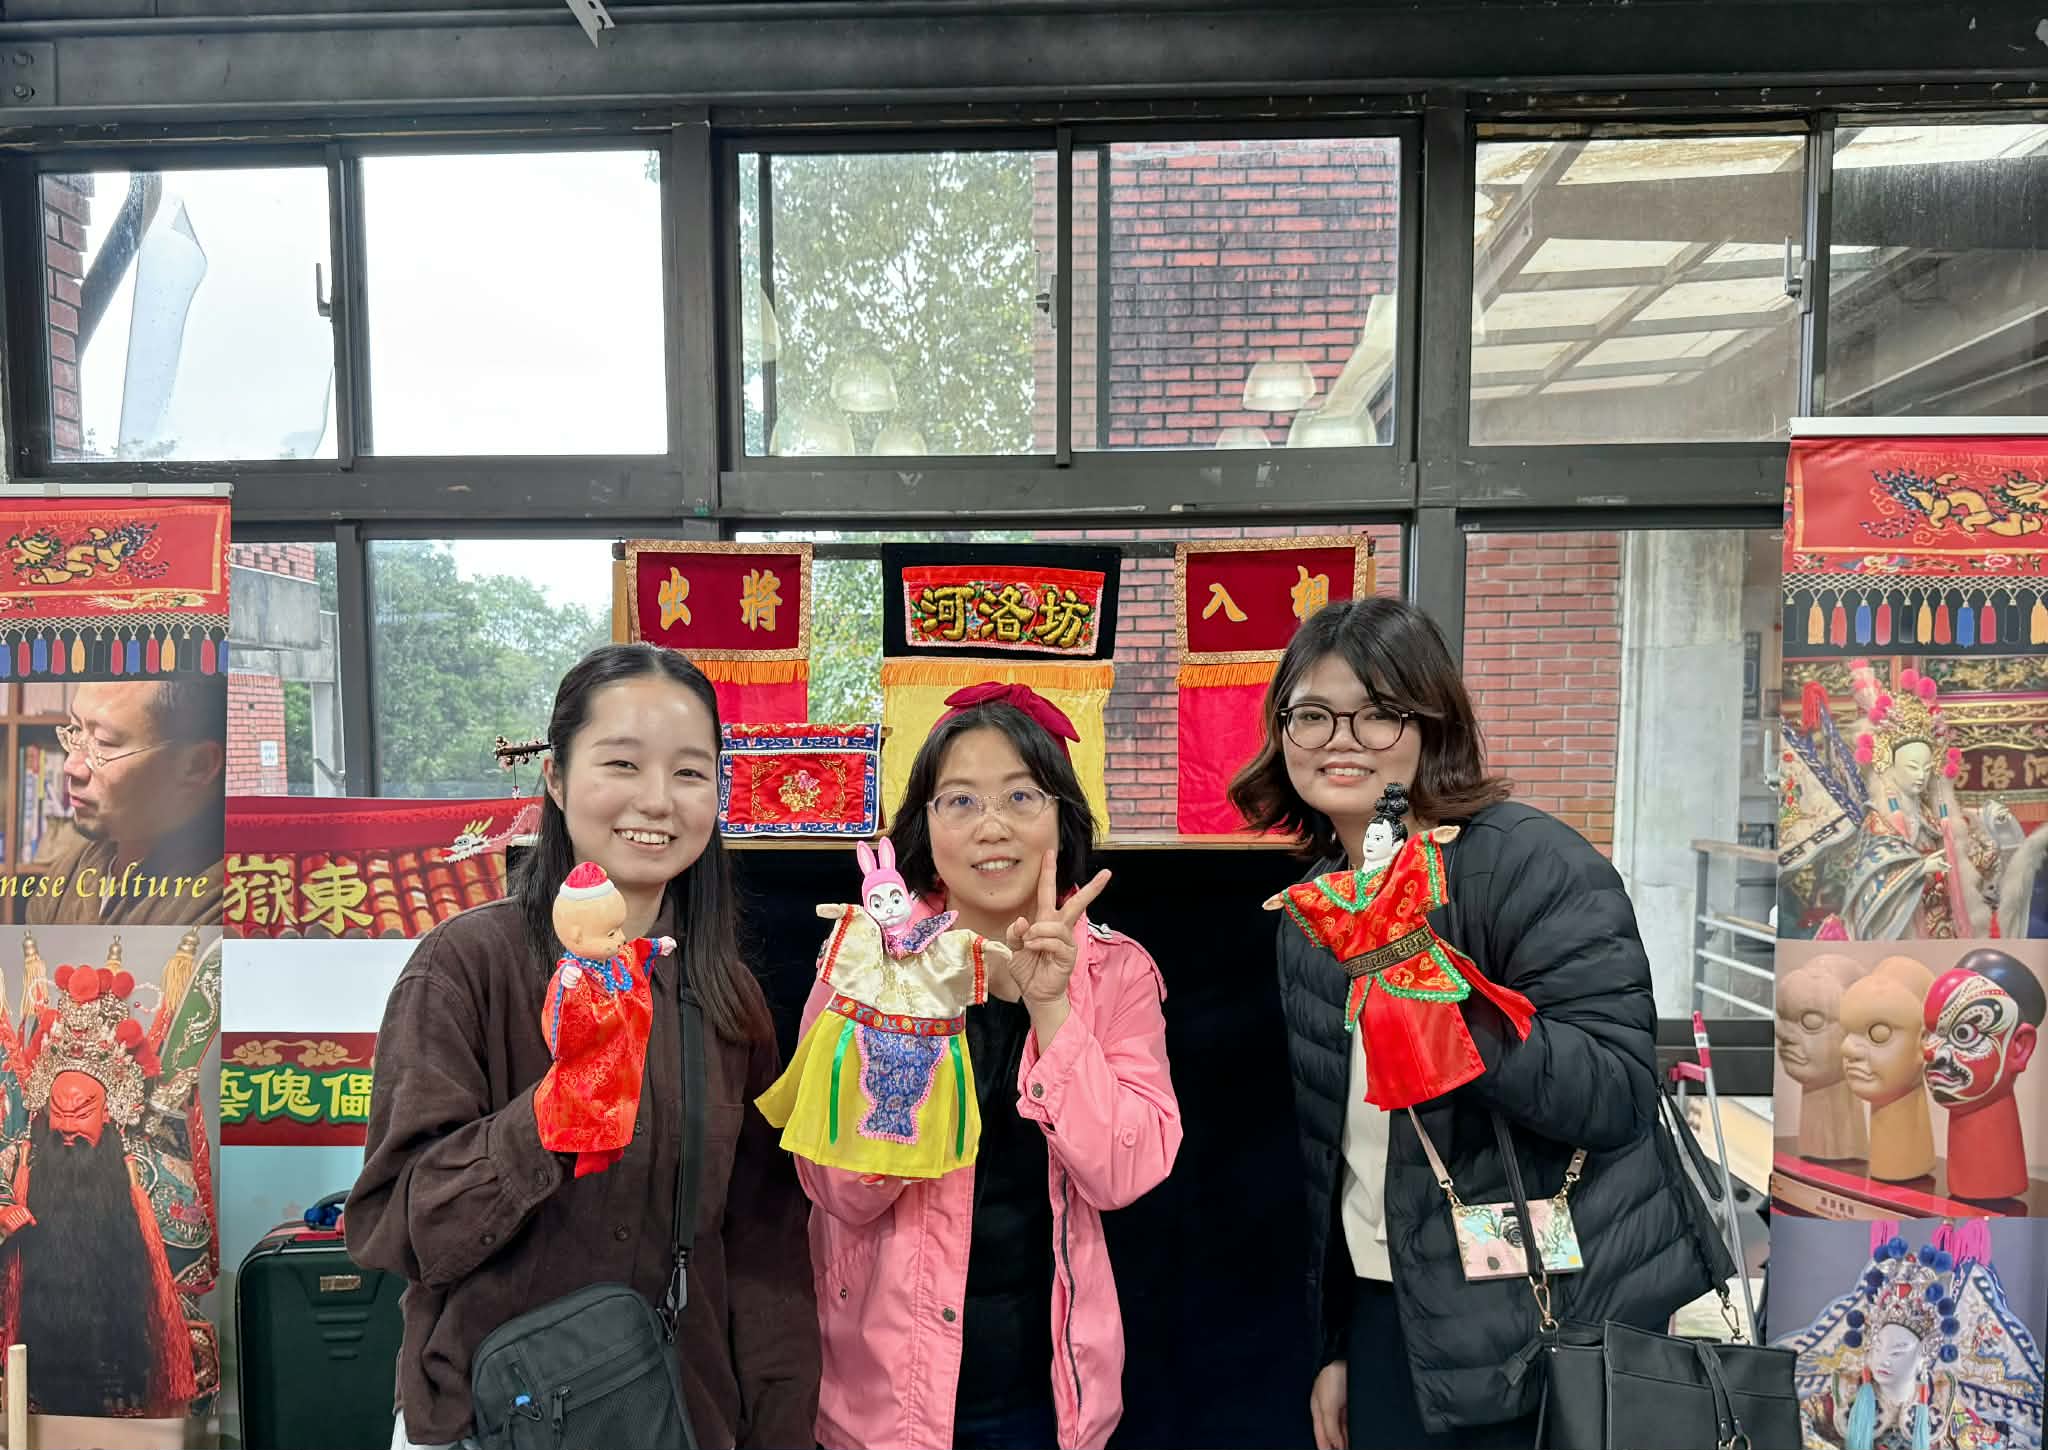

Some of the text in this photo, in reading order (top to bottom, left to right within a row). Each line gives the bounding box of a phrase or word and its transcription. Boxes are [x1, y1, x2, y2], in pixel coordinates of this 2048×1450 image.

[658, 567, 783, 632] 出將
[920, 585, 1090, 648] 河洛坊
[76, 862, 209, 897] Culture
